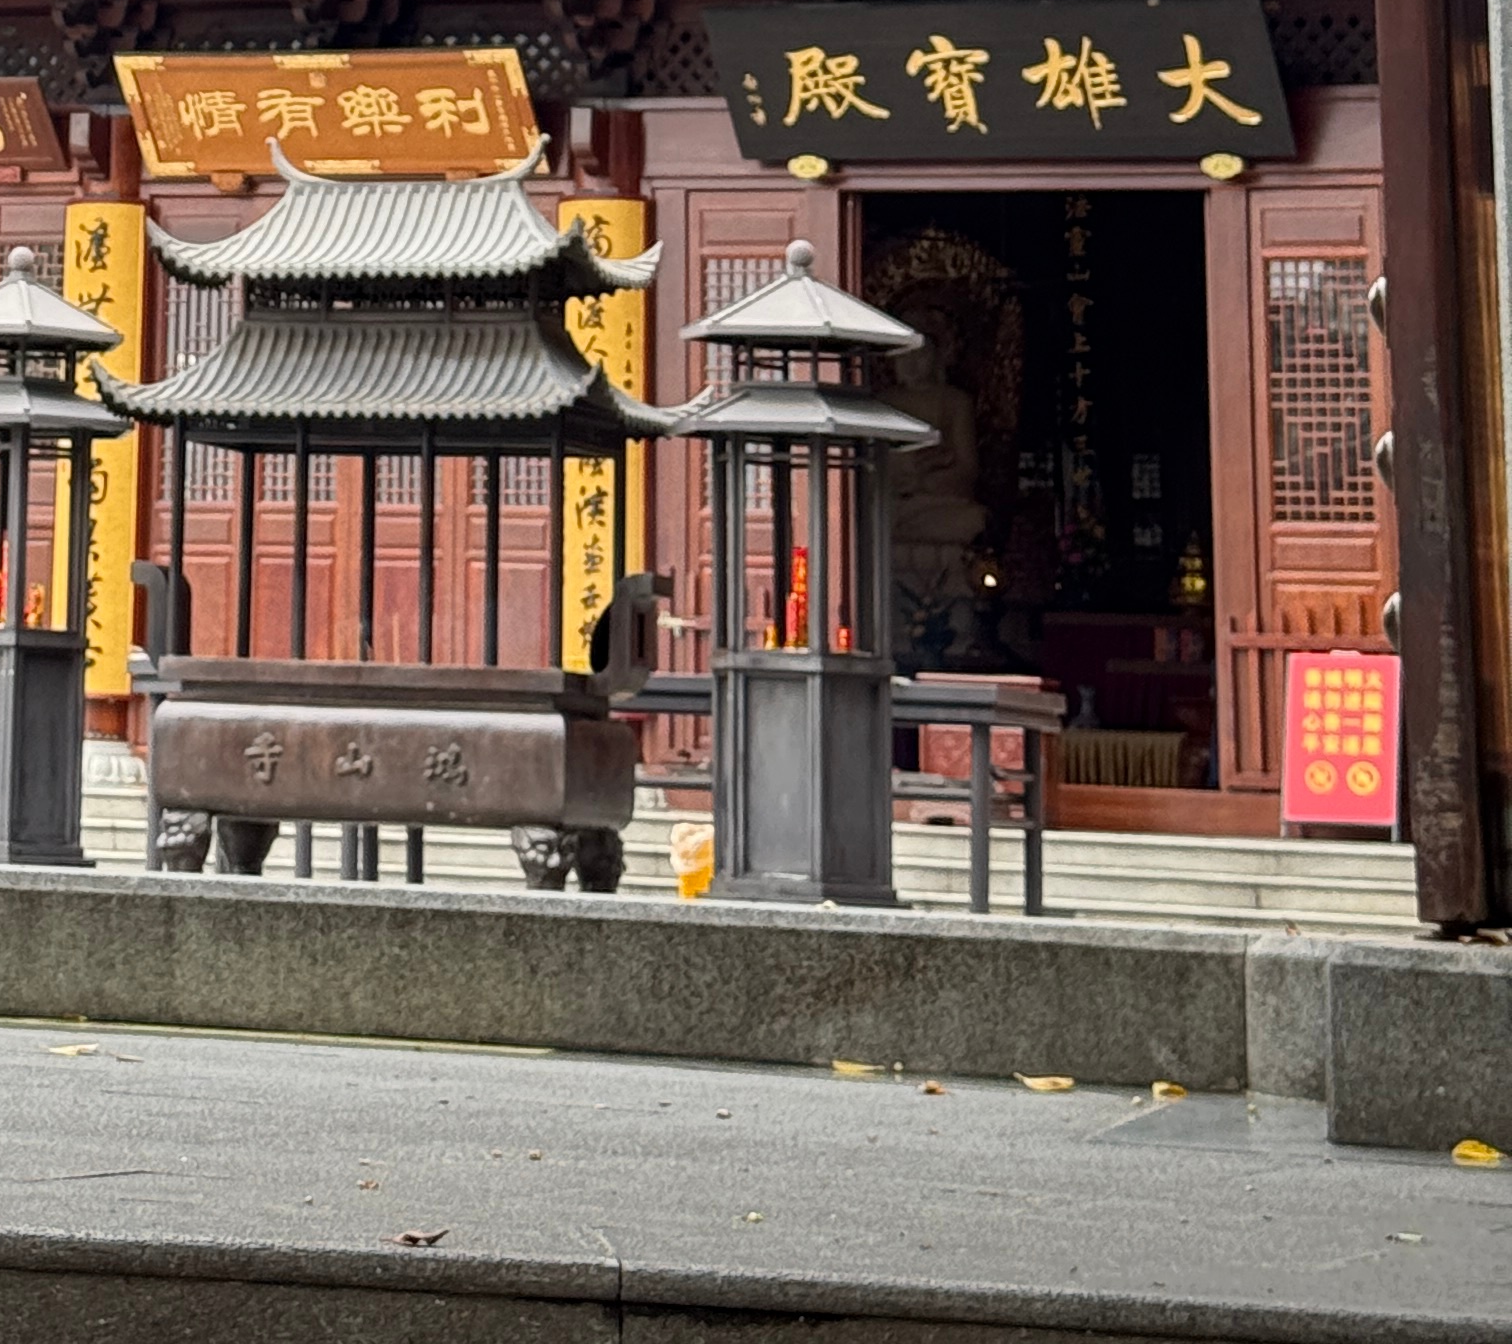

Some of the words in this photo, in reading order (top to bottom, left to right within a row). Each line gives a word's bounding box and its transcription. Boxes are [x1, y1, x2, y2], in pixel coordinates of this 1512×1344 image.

[178, 84, 491, 142] 利樂有情
[784, 33, 1263, 135] 大雄寶殿
